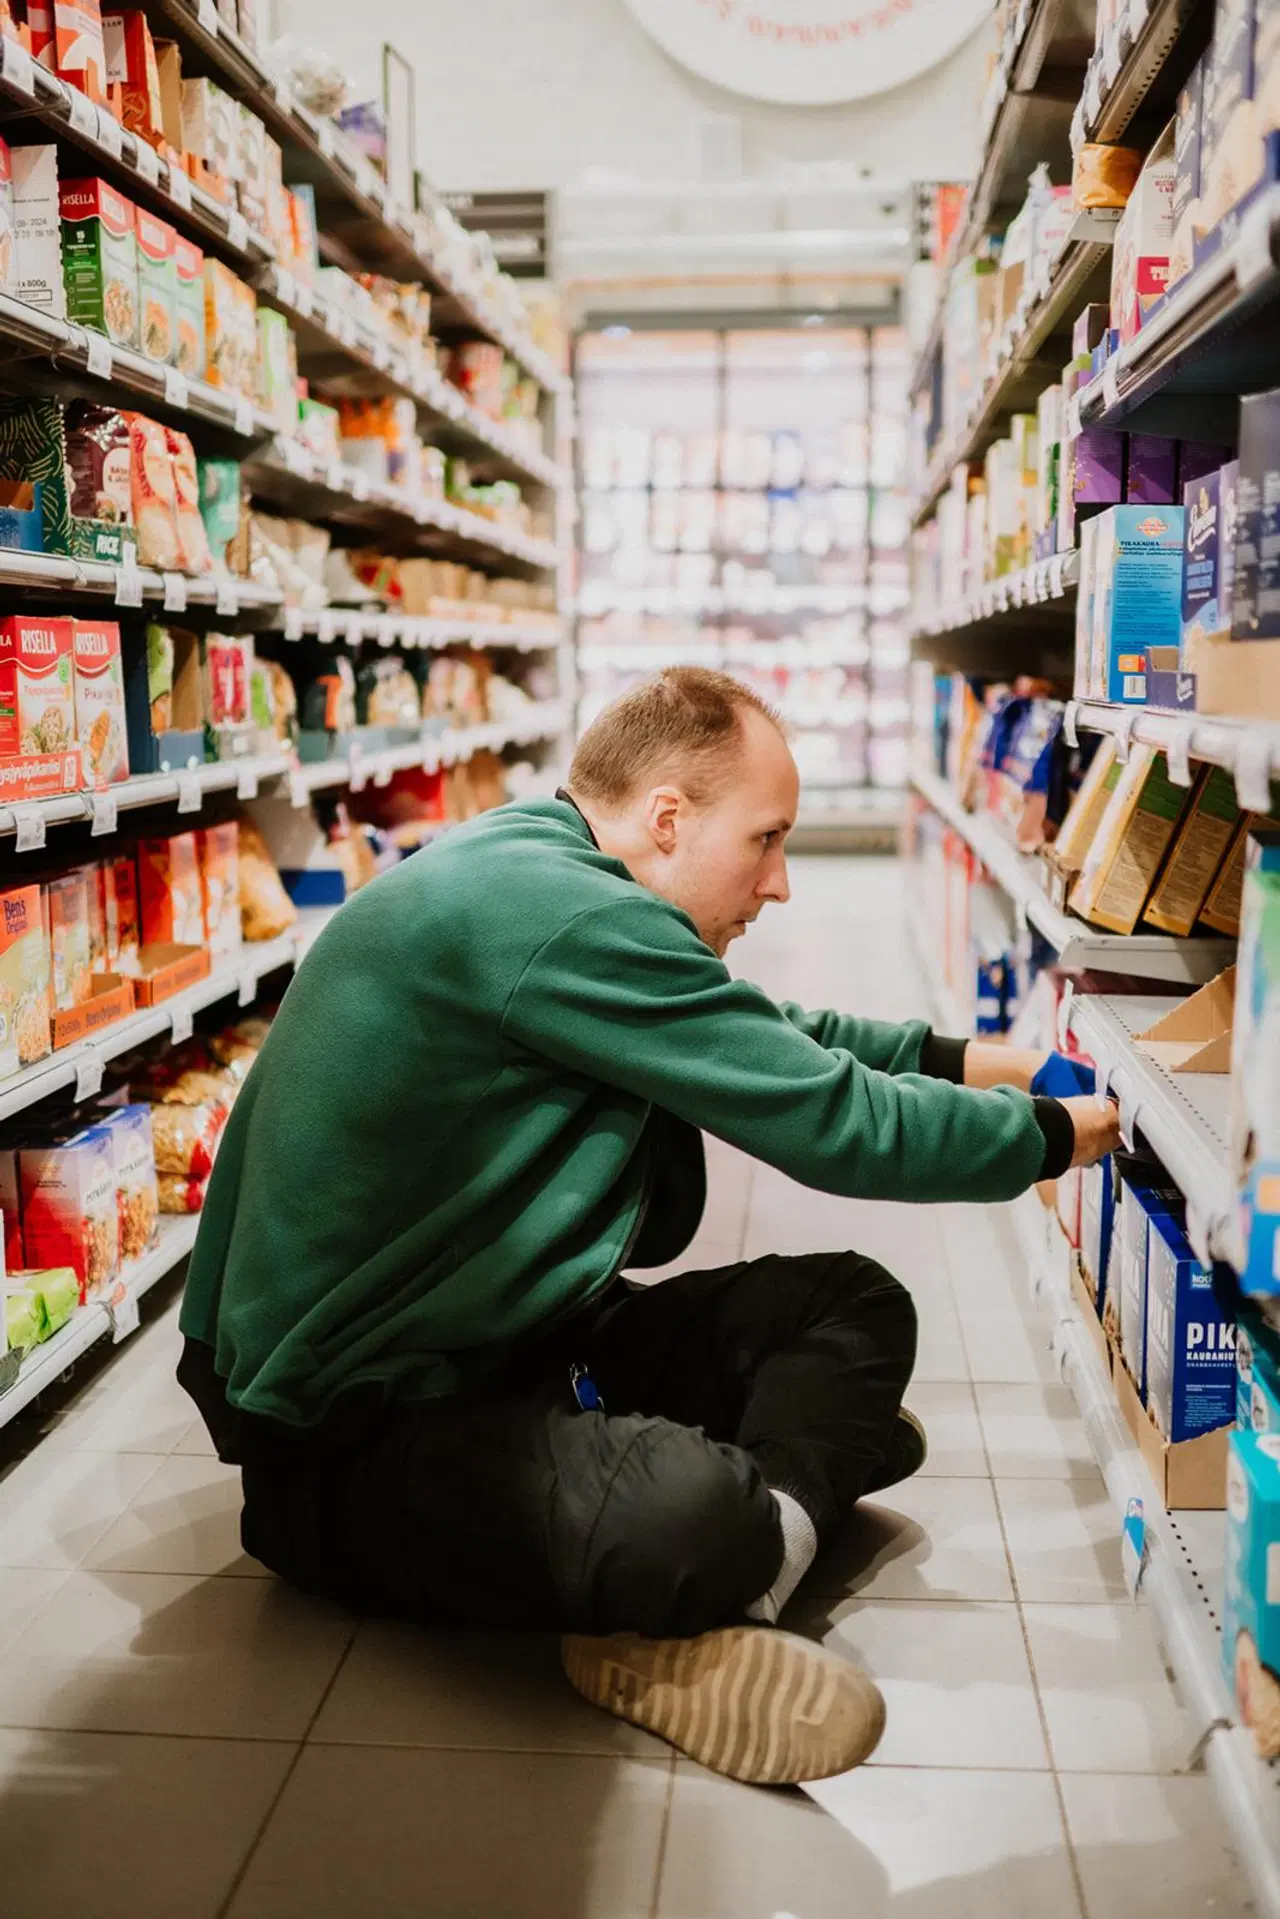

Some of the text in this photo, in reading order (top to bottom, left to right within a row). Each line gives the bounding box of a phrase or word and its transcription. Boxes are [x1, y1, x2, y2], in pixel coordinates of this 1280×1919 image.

[21, 629, 57, 655] RISELLA
[76, 633, 109, 657] RISELLA
[4, 896, 26, 921] Ben's
[1186, 1322, 1236, 1350] PIK
